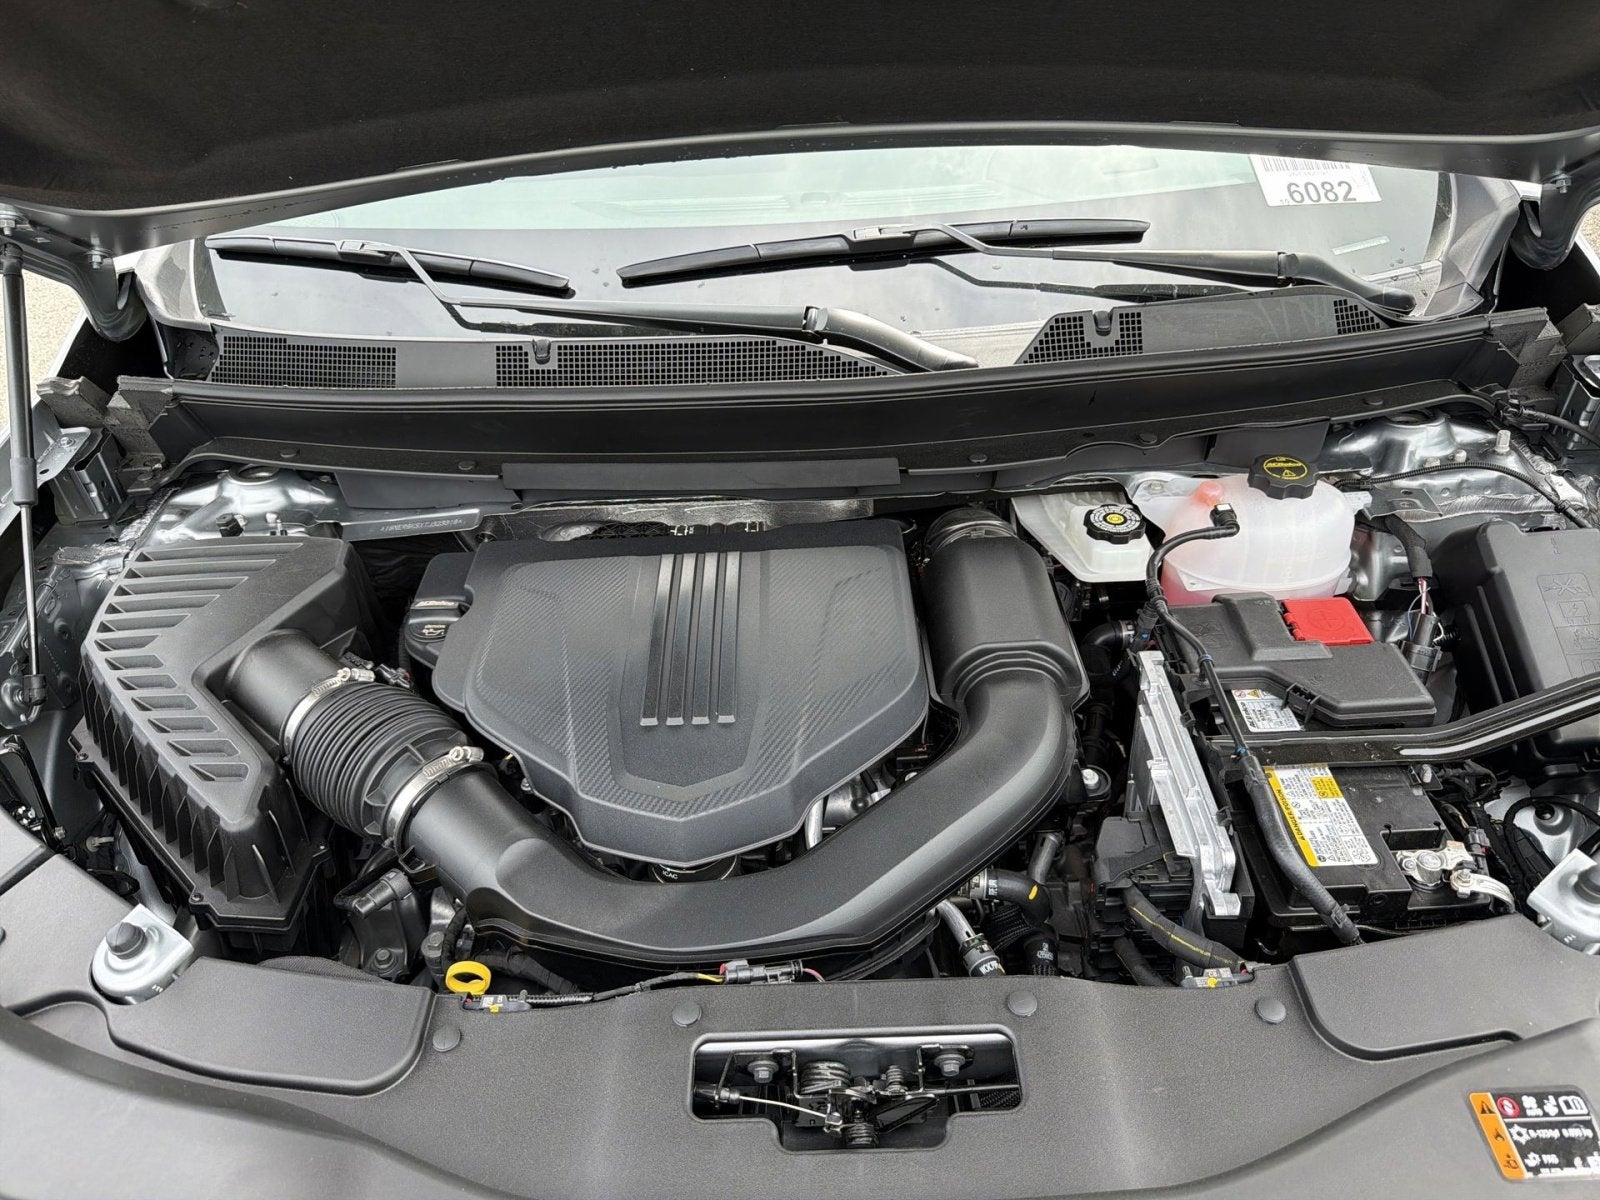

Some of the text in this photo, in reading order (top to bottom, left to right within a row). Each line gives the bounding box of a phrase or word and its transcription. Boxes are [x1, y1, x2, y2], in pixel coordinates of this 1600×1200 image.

[1286, 180, 1358, 204] 6082
[1276, 789, 1303, 837] DANGER POISON
